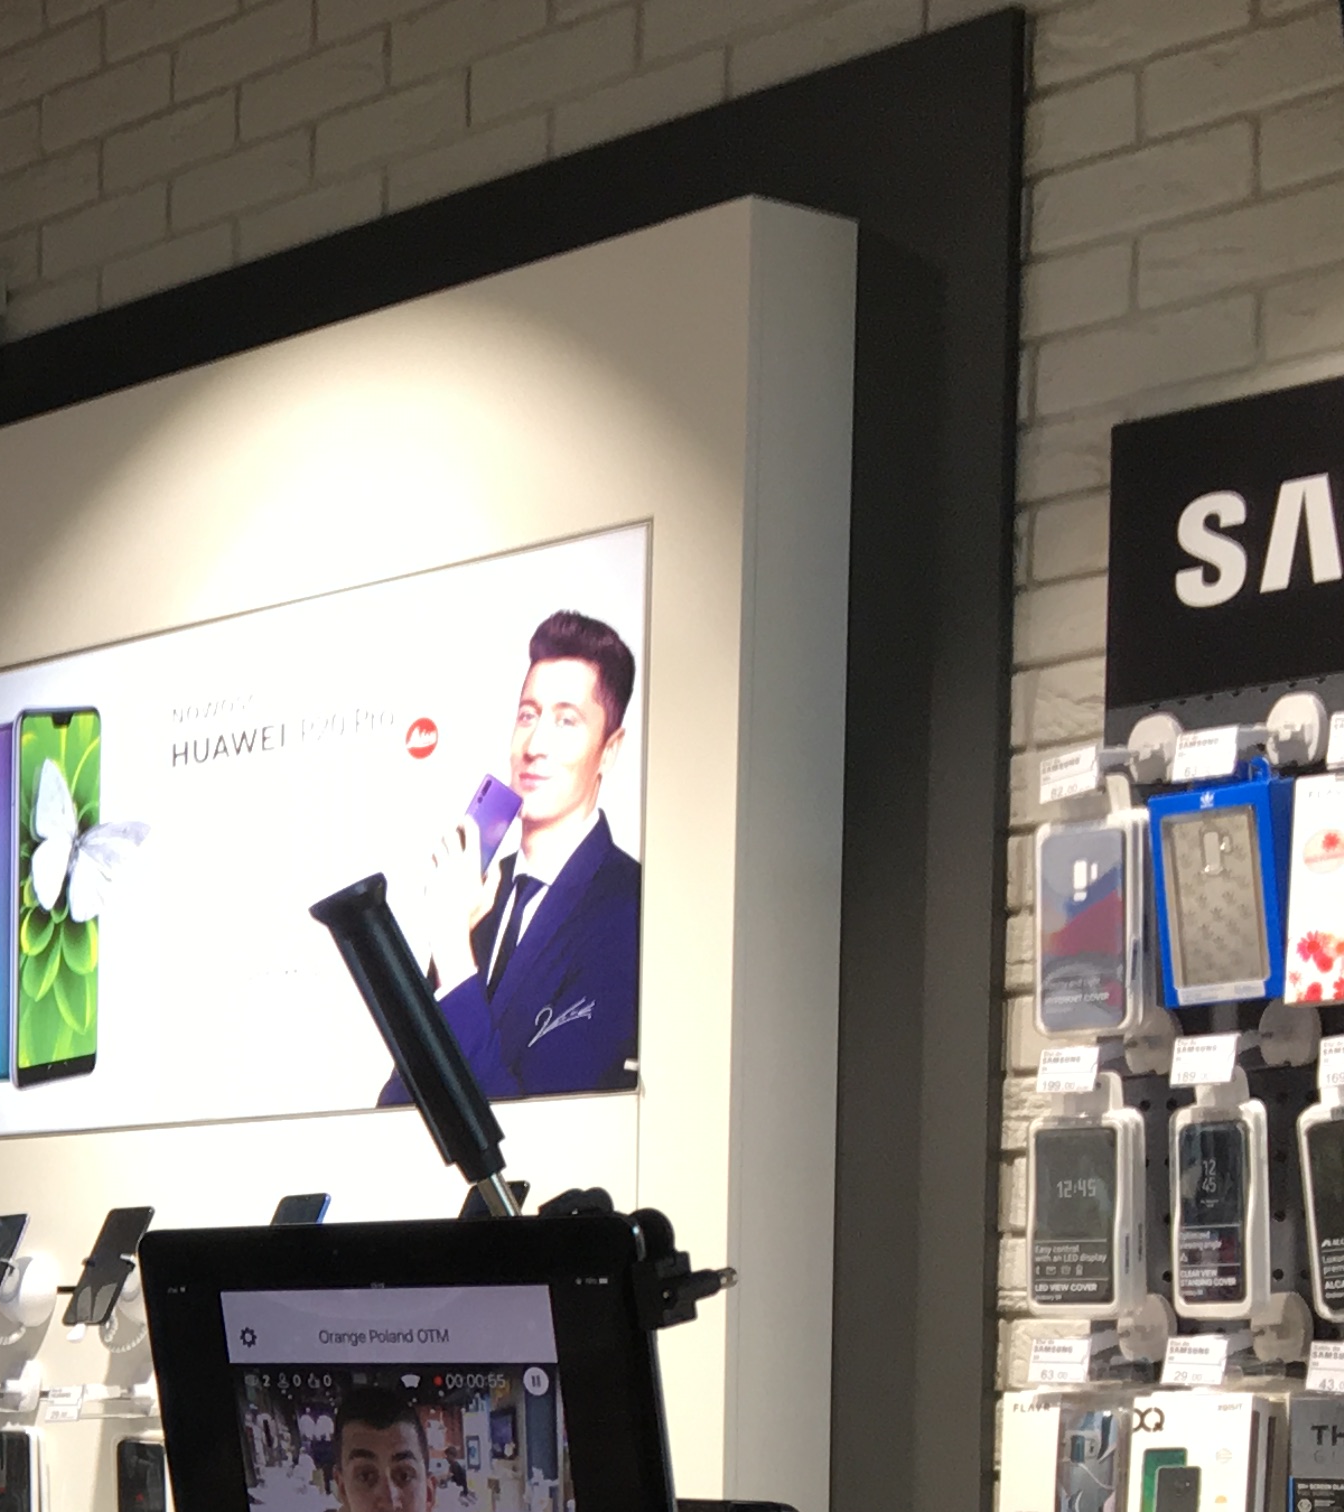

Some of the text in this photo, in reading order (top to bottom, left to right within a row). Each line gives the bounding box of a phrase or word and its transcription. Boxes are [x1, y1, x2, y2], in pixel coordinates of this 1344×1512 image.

[172, 723, 286, 767] HUAWEI
[1203, 1159, 1216, 1176] 12
[1034, 1283, 1098, 1292] LED VIEW COVER
[318, 1328, 450, 1347] Orange Poland OTM
